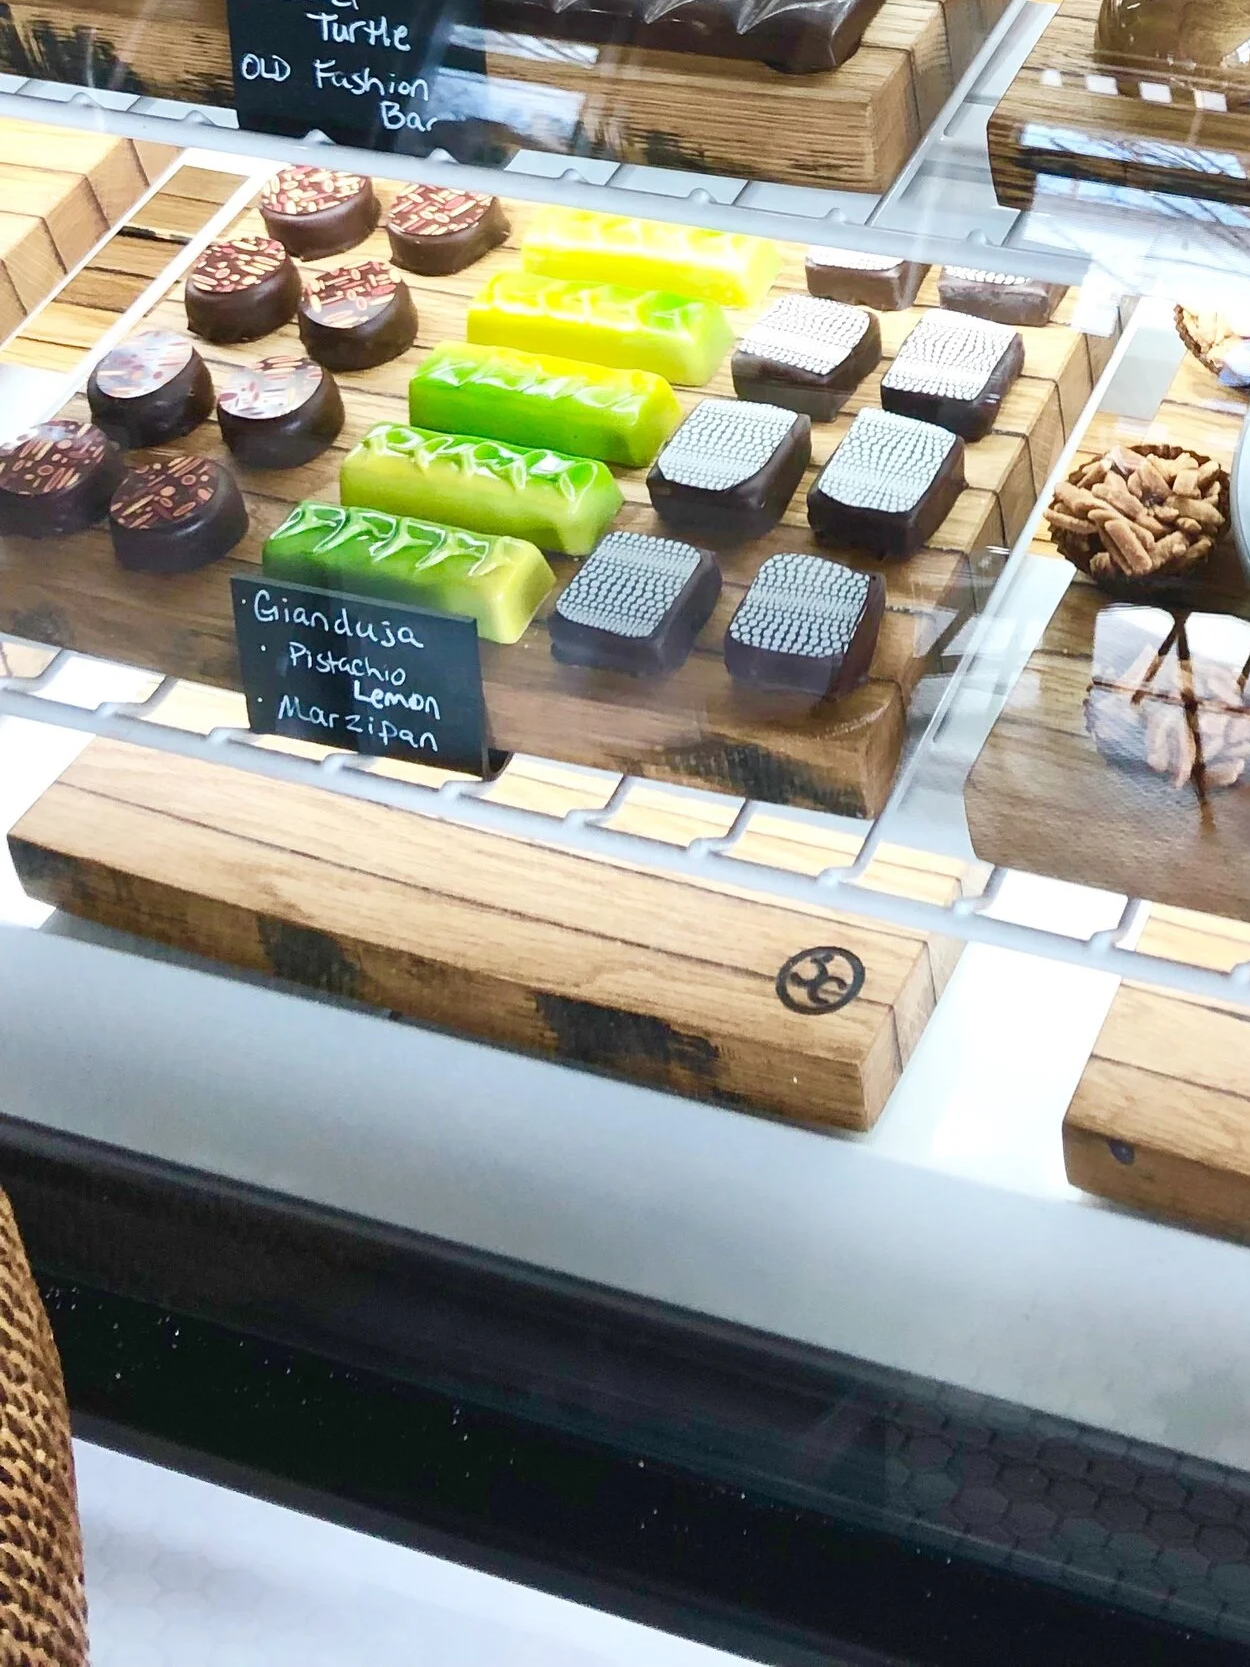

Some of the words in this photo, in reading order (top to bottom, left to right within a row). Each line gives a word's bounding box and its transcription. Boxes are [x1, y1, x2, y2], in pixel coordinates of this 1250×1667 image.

[306, 11, 412, 52] Turtle
[379, 100, 439, 133] Bar
[253, 589, 425, 649] Gianduja
[353, 679, 441, 721] Lemon
[276, 694, 439, 753] Marzipan
